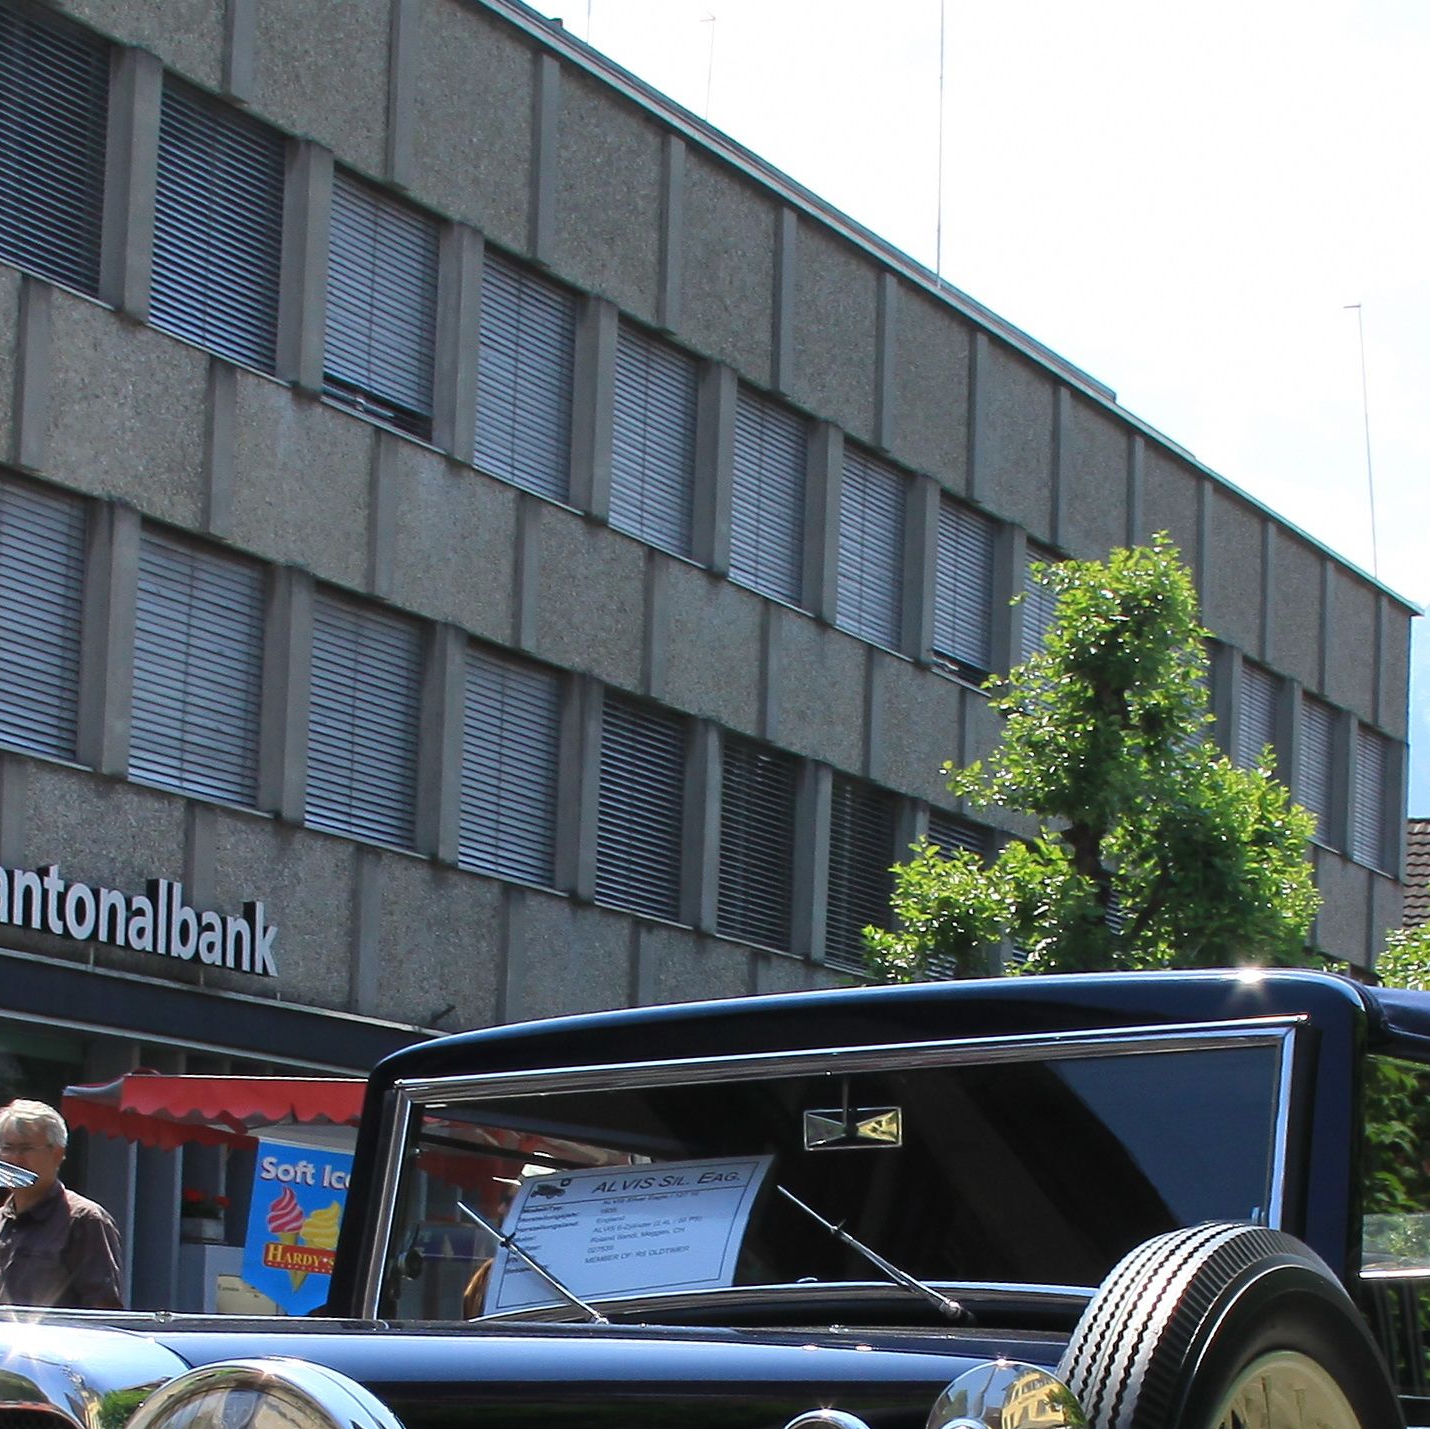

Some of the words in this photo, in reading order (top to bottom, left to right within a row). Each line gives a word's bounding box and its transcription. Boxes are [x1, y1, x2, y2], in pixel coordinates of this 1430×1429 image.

[260, 1156, 315, 1185] Soft
[592, 1177, 655, 1194] ALVIS
[697, 1172, 740, 1185] EAG.
